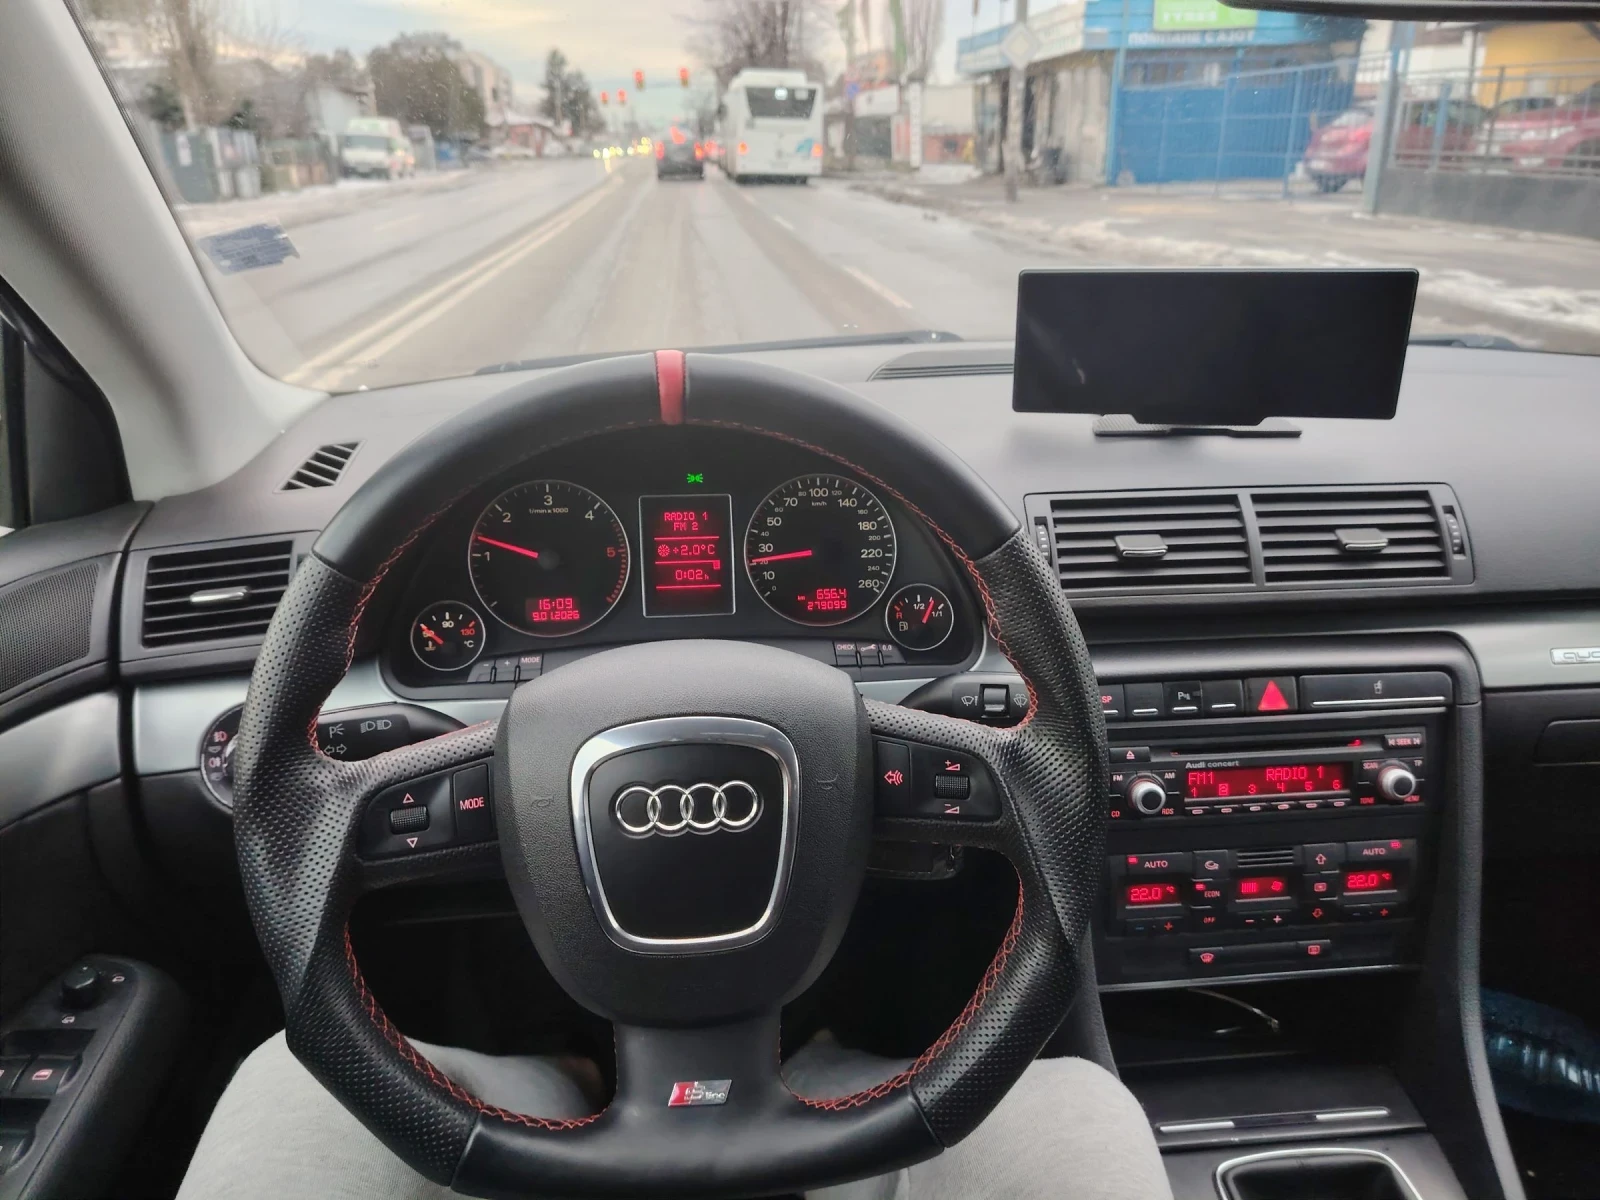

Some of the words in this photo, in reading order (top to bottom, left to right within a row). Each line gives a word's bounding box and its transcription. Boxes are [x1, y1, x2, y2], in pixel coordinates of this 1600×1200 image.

[809, 488, 829, 498] 100
[543, 494, 553, 506] 3
[784, 497, 798, 507] 70
[838, 498, 857, 508] 140
[502, 512, 511, 522] 2
[584, 511, 595, 521] 4
[664, 512, 695, 521] RADIO
[702, 512, 708, 520] 1
[673, 522, 687, 531] FM
[692, 522, 699, 531] 2
[766, 516, 782, 527] 50
[857, 521, 877, 531] 180
[606, 547, 616, 558] 5
[758, 543, 774, 553] 30
[483, 551, 491, 562] 1
[860, 549, 883, 559] 220
[763, 571, 775, 581] 10
[858, 579, 880, 589] 260
[539, 598, 573, 610] 16:09
[807, 600, 848, 611] 279099
[913, 603, 926, 611] 1/2
[896, 612, 903, 620] R
[441, 621, 455, 629] 90
[1101, 696, 1113, 704] SP
[1185, 761, 1206, 769] Audi
[1207, 760, 1240, 768] concert
[1112, 774, 1123, 782] FM
[1164, 772, 1176, 780] AM
[1266, 767, 1307, 781] RADIO
[1317, 766, 1324, 778] 1
[1191, 786, 1197, 797] 1
[1248, 784, 1256, 794] 3
[1276, 783, 1285, 793] 4
[1304, 781, 1313, 791] 5
[1332, 779, 1341, 790] 6
[459, 797, 485, 810] MODE
[1111, 810, 1121, 818] CD
[1347, 874, 1378, 888] 22.0
[1130, 887, 1162, 901] 22.0
[1204, 890, 1220, 898] ECON
